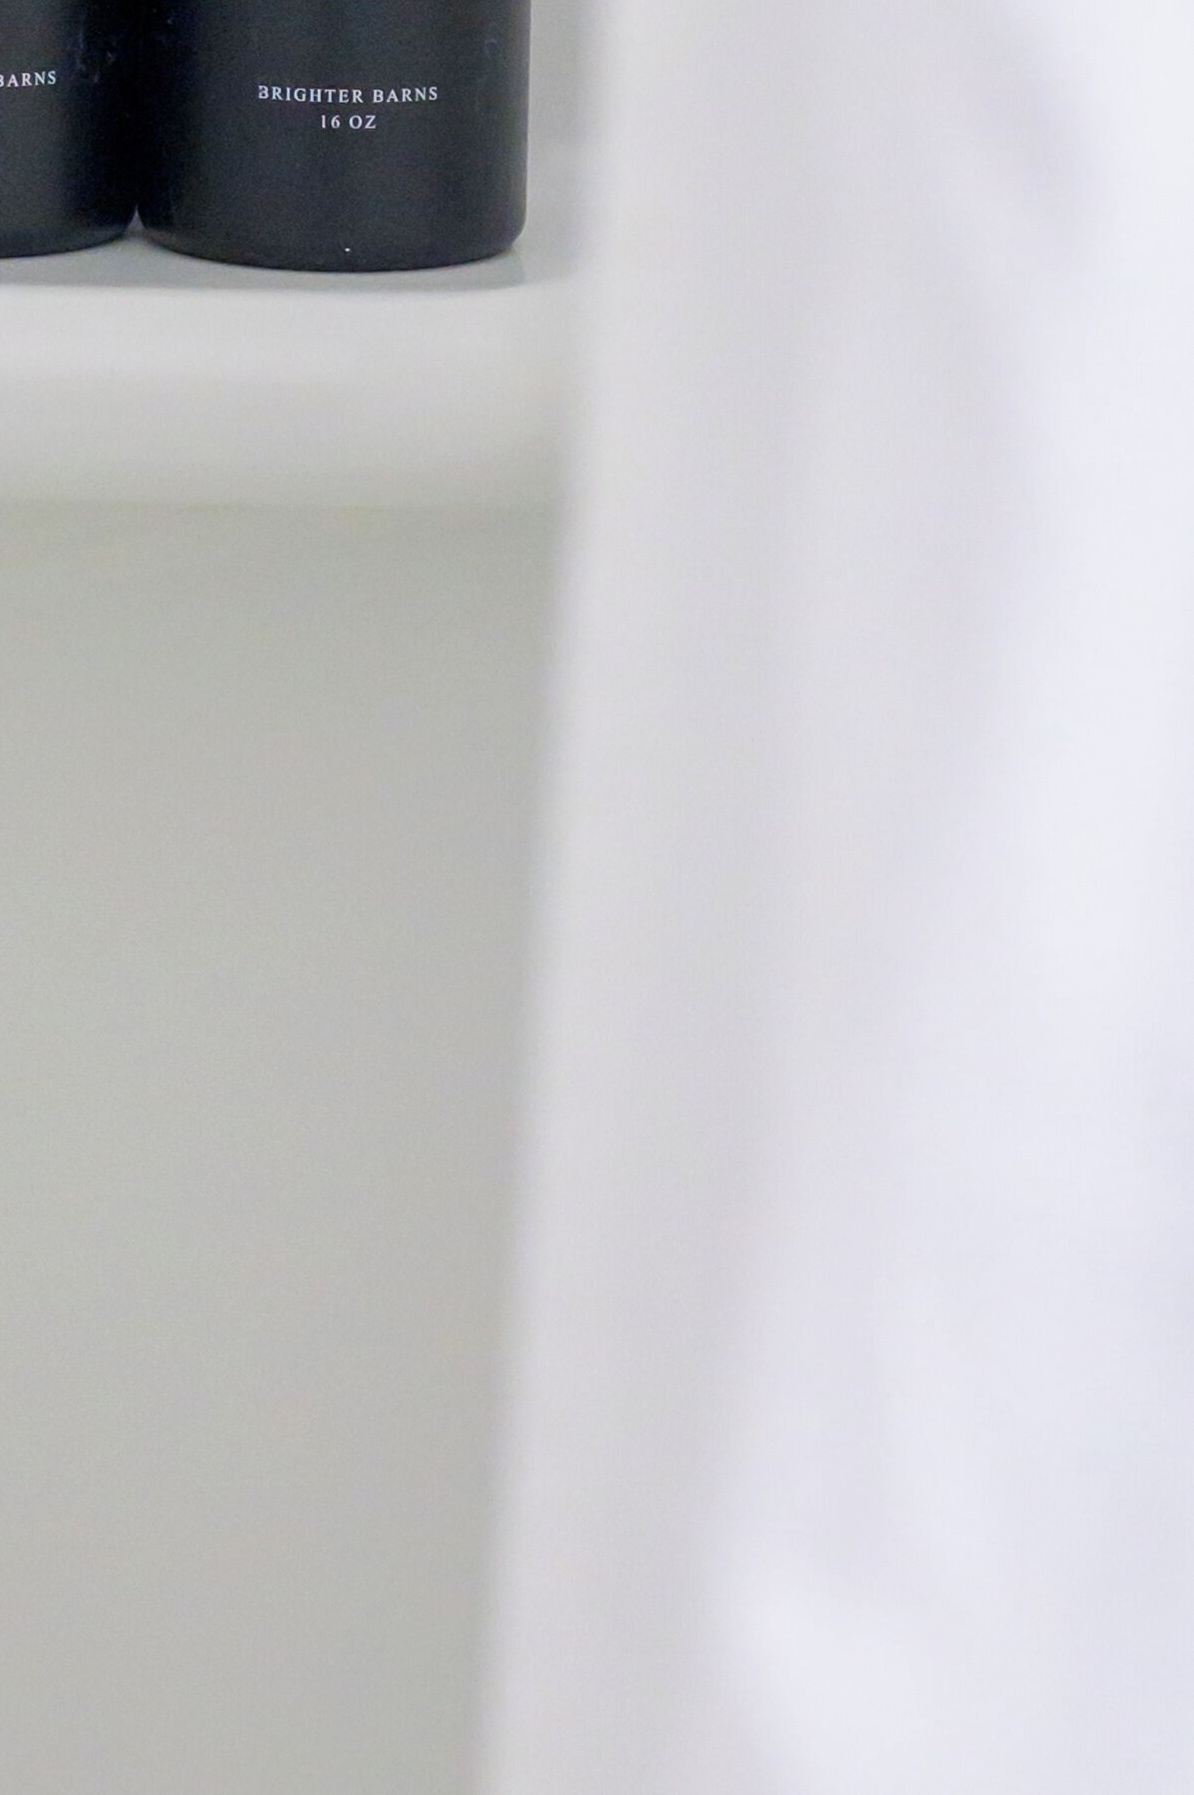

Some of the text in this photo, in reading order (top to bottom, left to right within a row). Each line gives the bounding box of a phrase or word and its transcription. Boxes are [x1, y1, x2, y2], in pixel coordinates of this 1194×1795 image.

[258, 85, 439, 104] BRIGHTER BARNS
[321, 114, 376, 130] 16 OZ
